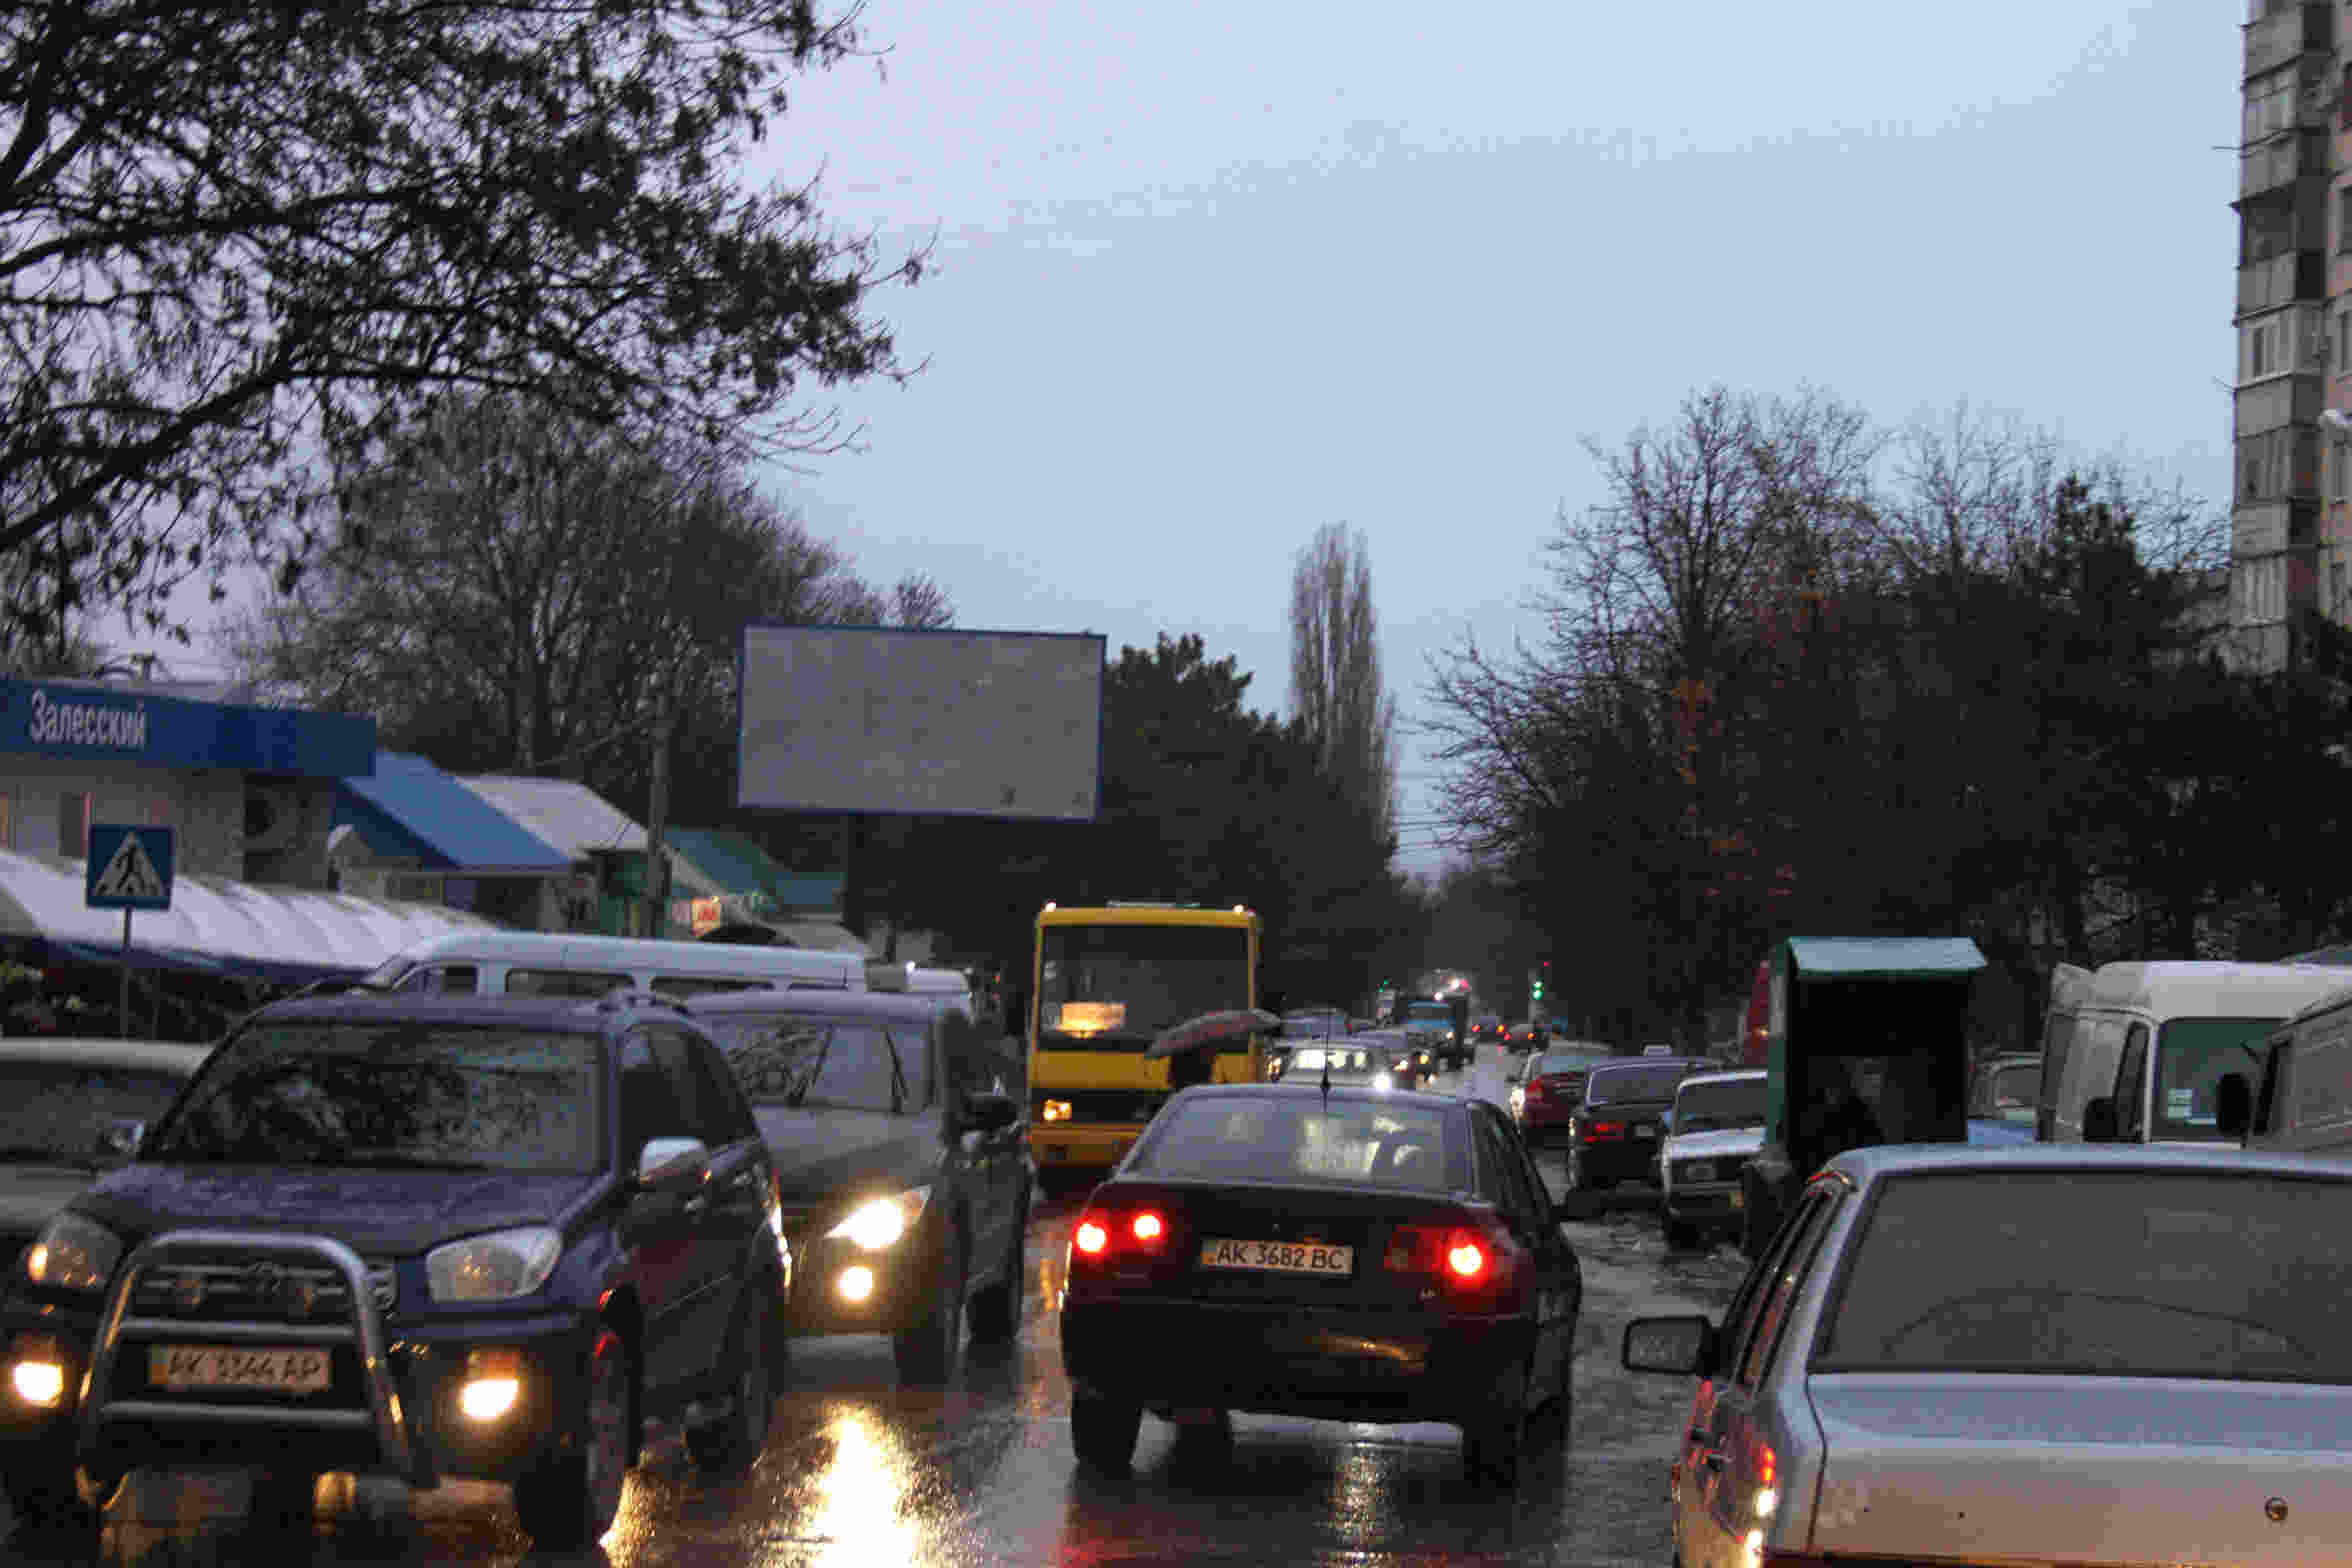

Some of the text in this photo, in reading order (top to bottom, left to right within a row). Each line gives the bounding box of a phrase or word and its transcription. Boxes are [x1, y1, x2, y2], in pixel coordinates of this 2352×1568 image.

[29, 688, 146, 747] Залесский
[1216, 1241, 1249, 1264] AK
[1311, 1248, 1345, 1270] BC
